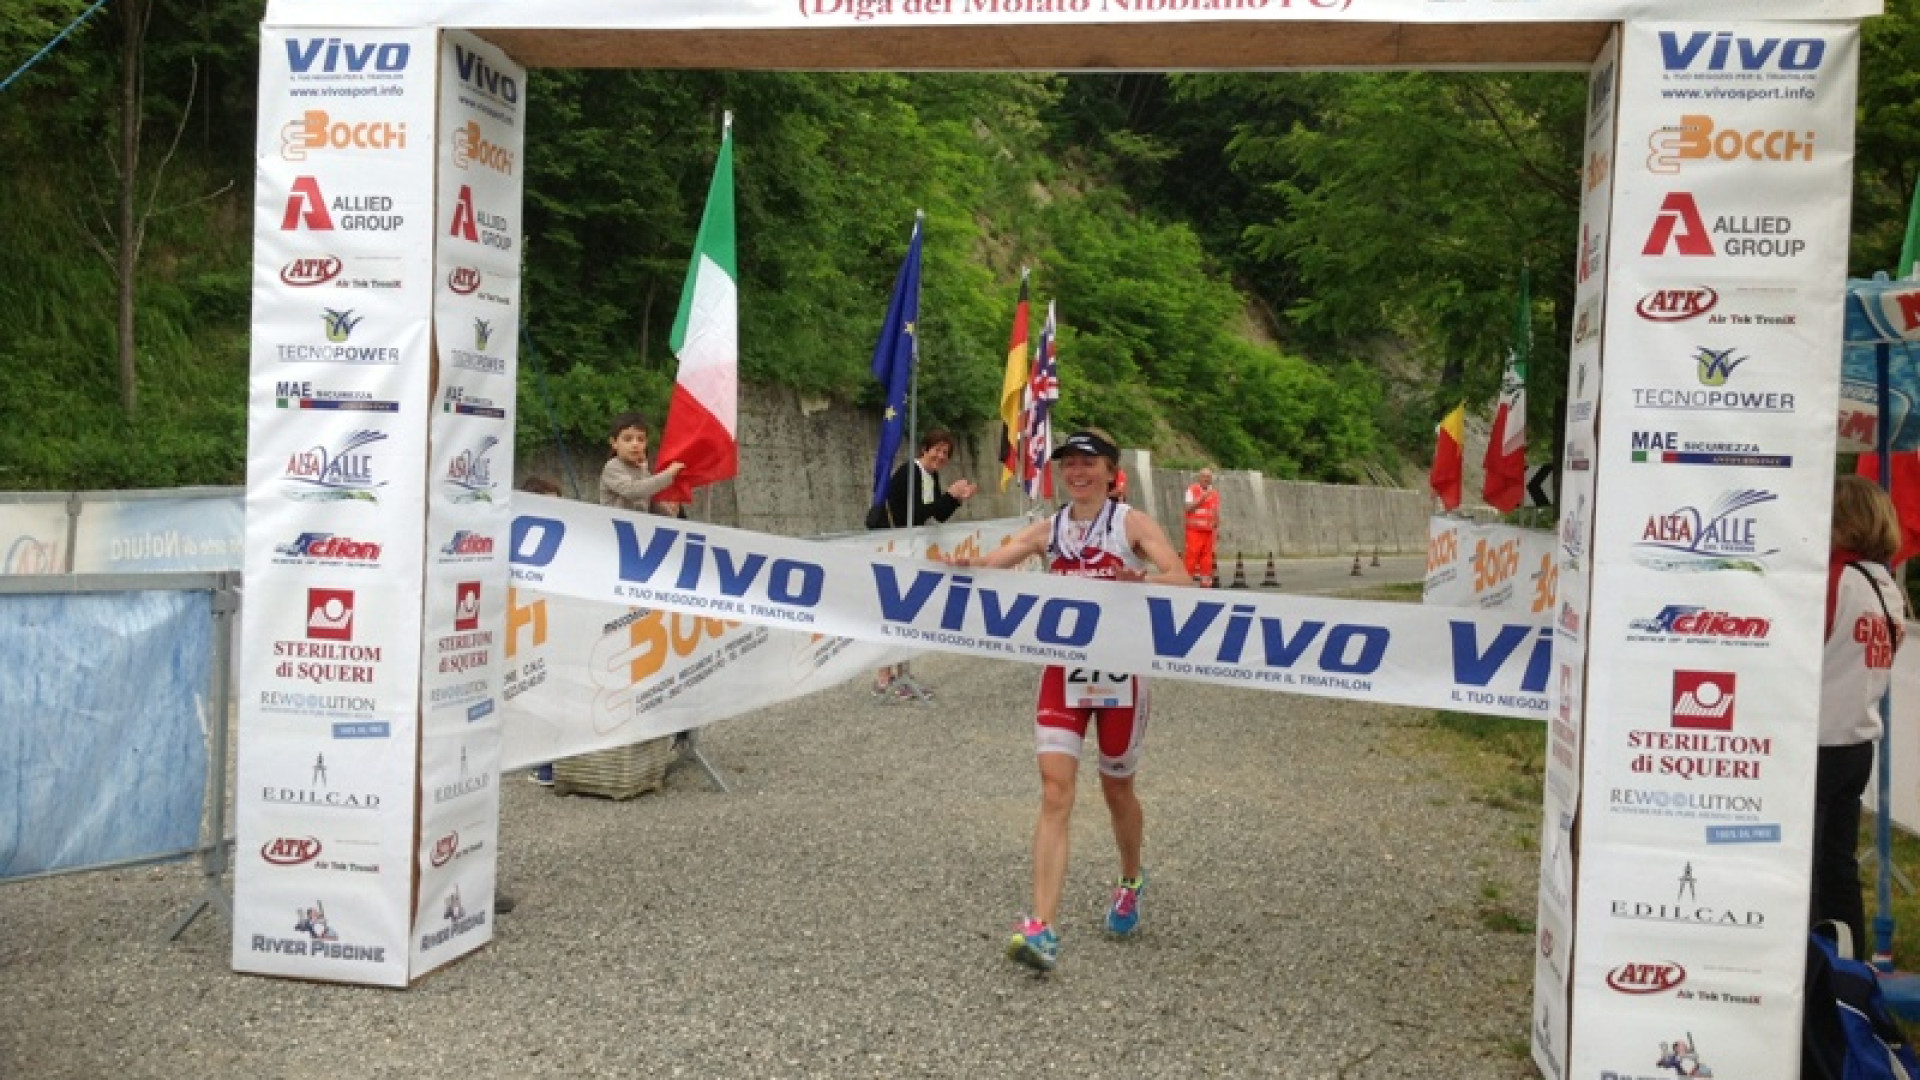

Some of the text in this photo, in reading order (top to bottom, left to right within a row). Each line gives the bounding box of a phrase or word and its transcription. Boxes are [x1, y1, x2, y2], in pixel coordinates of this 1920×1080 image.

[285, 38, 411, 73] Vivo
[1658, 31, 1827, 71] Vivo
[456, 43, 517, 103] Vivo
[1661, 86, 1815, 101] www.vivosport.info
[332, 197, 392, 211] ALLIED
[341, 215, 404, 230] GROUP
[1713, 215, 1792, 235] ALLIED
[1724, 239, 1806, 257] GROUP
[287, 257, 334, 279] ATK
[1645, 288, 1709, 315] ATK
[1708, 314, 1728, 325] Air
[277, 345, 399, 361] TECNOPOWER
[275, 381, 312, 397] MAE
[1632, 388, 1796, 409] TECNOPOWER
[1631, 431, 1679, 450] MAE
[611, 518, 825, 607] Vivo
[629, 586, 651, 600] TUO
[654, 591, 708, 608] NEGOZIO
[710, 599, 733, 611] PER
[750, 604, 814, 623] TRIATHLON
[870, 562, 1103, 647] Vivo
[880, 624, 1087, 661] IL TUO NEGOZIO PER IL TRIATHLON
[1146, 597, 1390, 675] Vivo
[273, 641, 381, 662] STERILTOM
[275, 662, 374, 684] di SQUERI
[1151, 660, 1371, 691] IL TUO NEGOZIO PER IL TRIATHLON
[1451, 690, 1462, 701] IL
[1466, 691, 1494, 704] TUO
[1627, 730, 1772, 755] STERILTOM
[1631, 755, 1762, 780] di SQUERI
[263, 786, 380, 807] EDILCAD
[269, 837, 314, 858] ATK
[1610, 900, 1765, 926] EDILCAD
[252, 934, 385, 963] RIVER PISCINE
[1616, 962, 1677, 989] ATK
